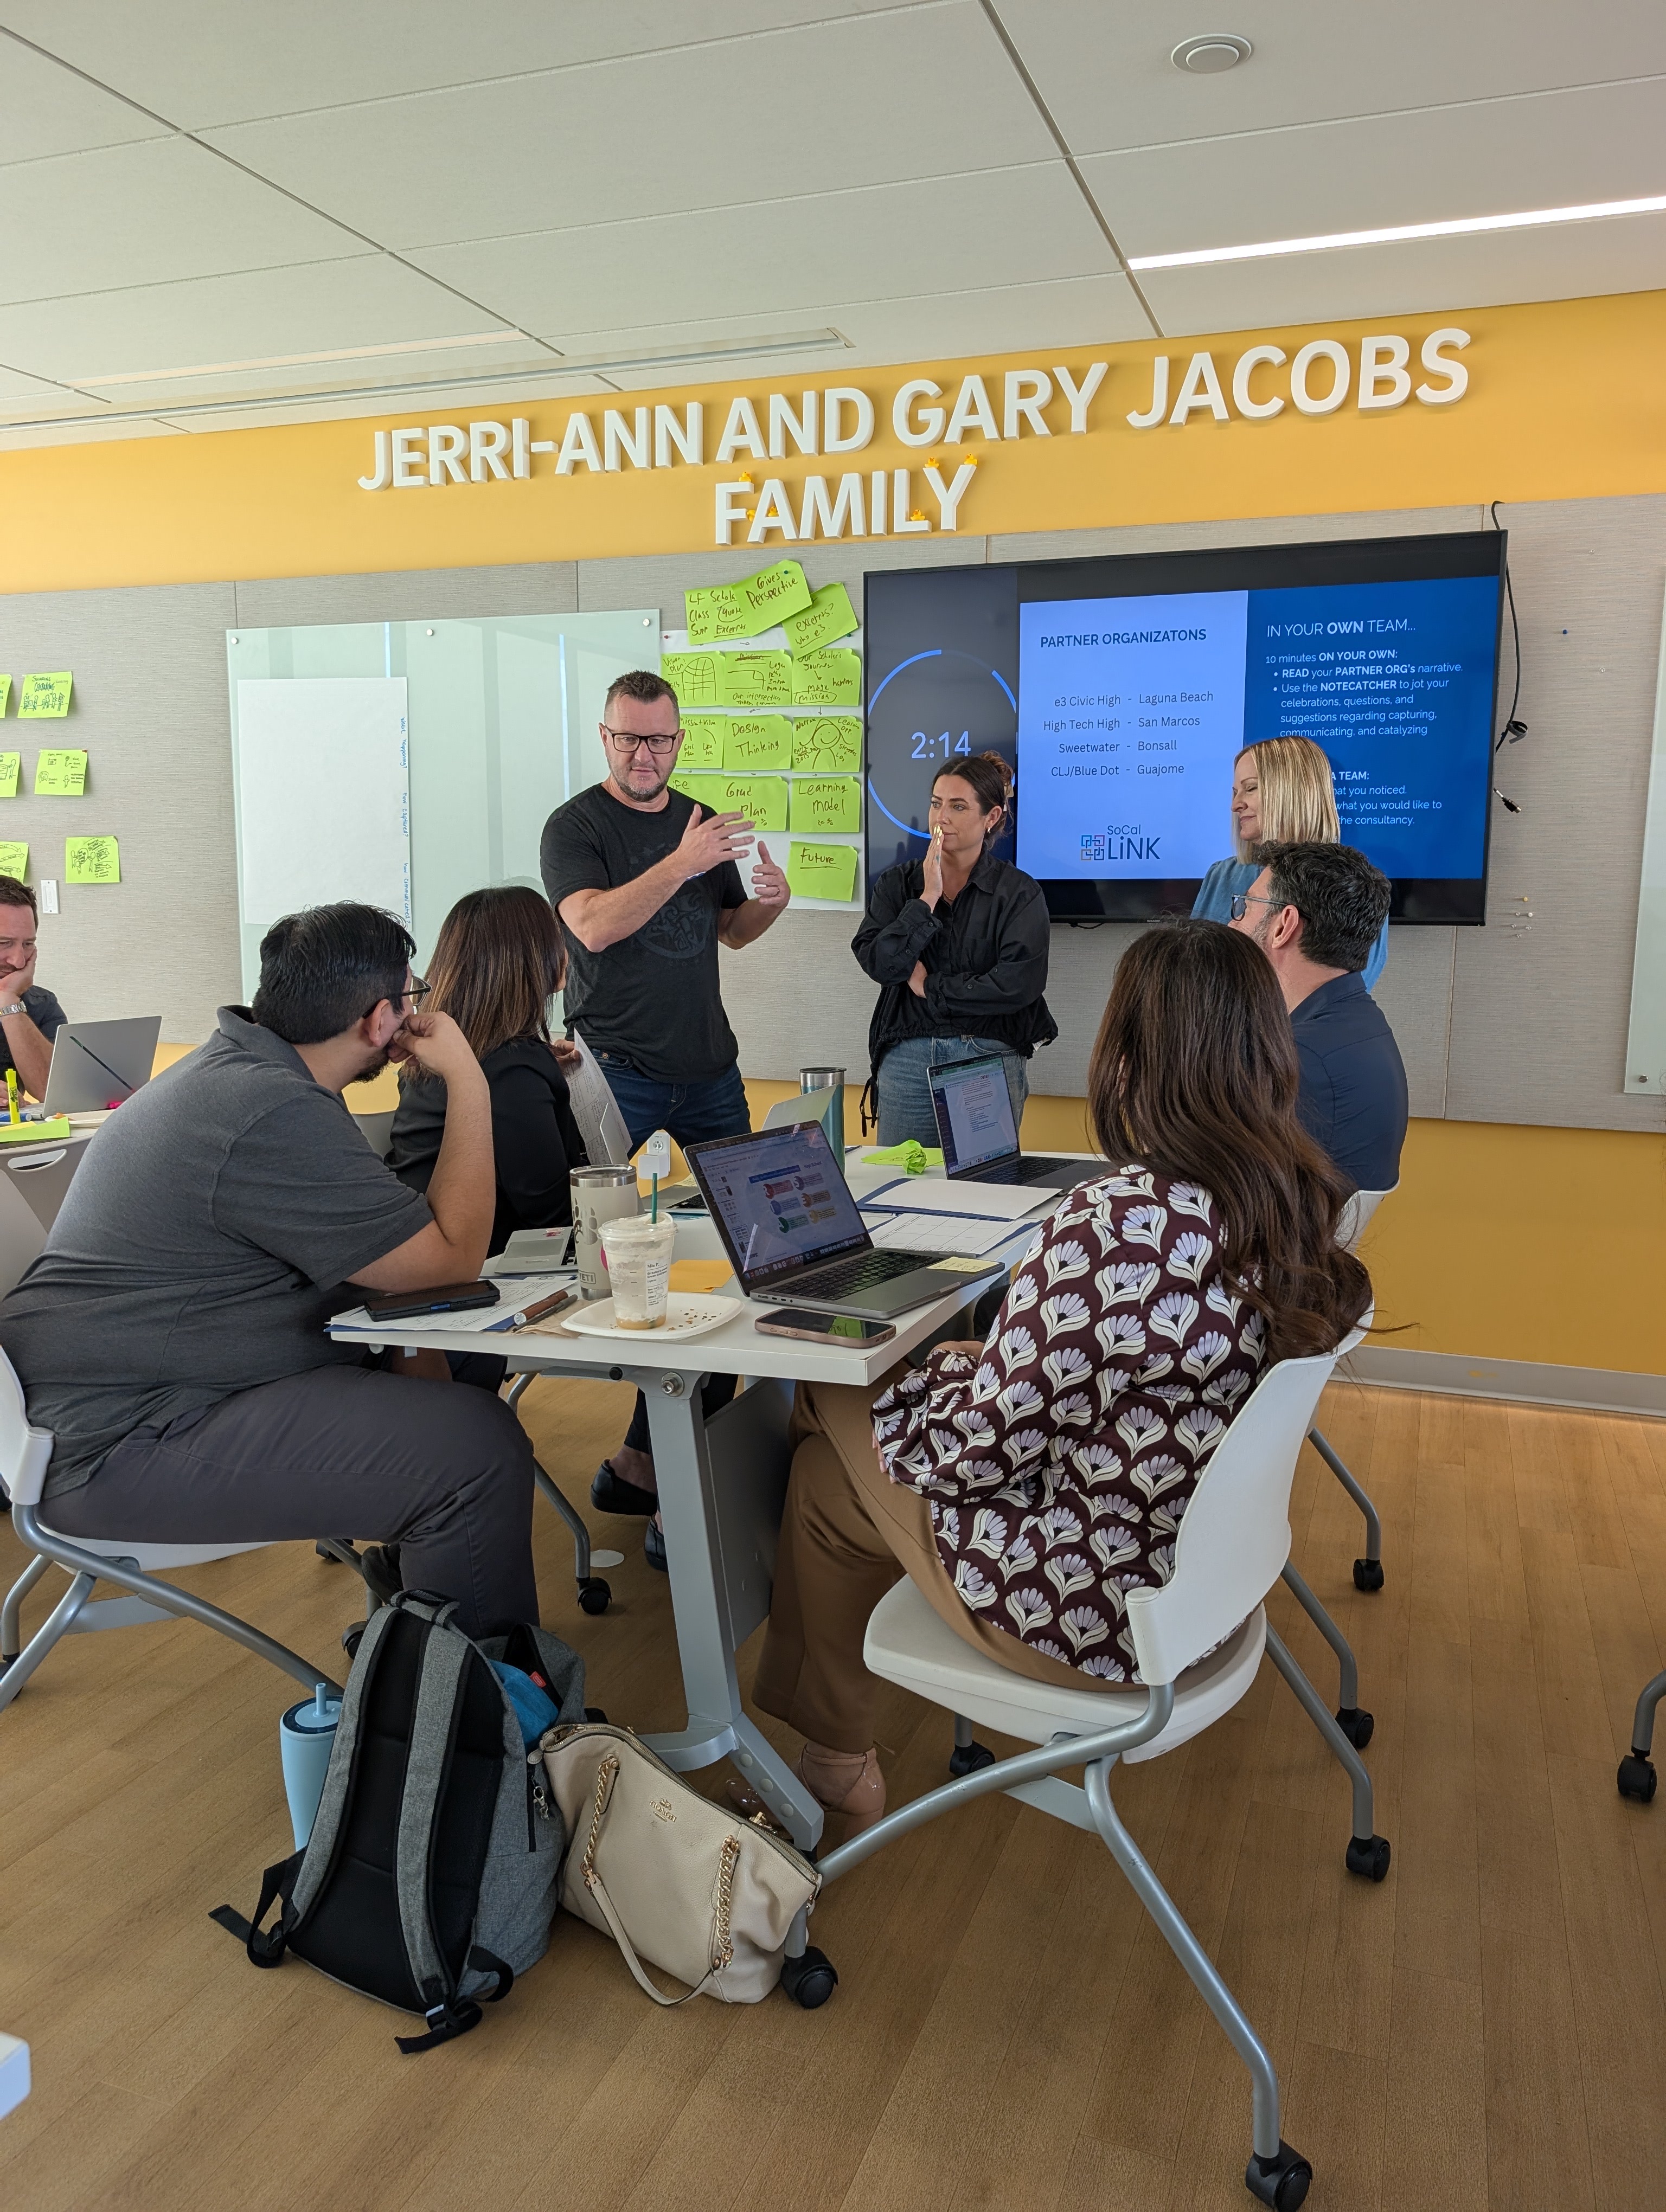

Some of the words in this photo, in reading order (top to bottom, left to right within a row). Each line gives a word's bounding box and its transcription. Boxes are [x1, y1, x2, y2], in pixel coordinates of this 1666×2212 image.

[357, 401, 703, 492] JERRI-ANN
[715, 387, 876, 462] AND
[892, 362, 1109, 449] GARY
[1125, 327, 1472, 430] JACOBS
[715, 464, 977, 546] FAMILY
[745, 577, 799, 610] Perspective
[1267, 625, 1280, 638] IN
[1284, 622, 1323, 636] YOUR
[1327, 620, 1364, 634] OWN
[1367, 618, 1416, 633] TEAM...
[1041, 634, 1099, 648] PARTNER
[1102, 628, 1207, 645] ORGANIZATONS
[1266, 655, 1276, 664] 10
[1279, 653, 1316, 663] minutes
[1319, 652, 1334, 661] ON
[1336, 650, 1366, 661] YOUR
[1368, 649, 1398, 659] OWN:
[1282, 668, 1309, 678] READ
[1311, 669, 1333, 679] your
[1335, 665, 1383, 676] PARTNER
[1385, 664, 1415, 674] ORG's
[1418, 663, 1463, 673] narrative.
[1281, 683, 1300, 693] Use
[1303, 683, 1318, 692] the
[1320, 680, 1397, 692] NOTECATCHER
[1399, 680, 1409, 689] to
[1410, 678, 1424, 690] jot
[1427, 680, 1450, 690] your
[1054, 697, 1066, 707] e3
[1069, 695, 1094, 706] Civic
[1098, 695, 1121, 708] High
[1139, 693, 1177, 706] Laguna
[1181, 691, 1214, 702] Beach
[1281, 697, 1341, 708] celebrations,
[1343, 696, 1392, 708] questions,
[1395, 694, 1414, 704] and
[1043, 719, 1066, 732] High
[1069, 718, 1094, 730] Tech
[1097, 718, 1120, 731] High
[1138, 717, 1157, 728] San
[1161, 716, 1200, 726] Marcos
[1280, 712, 1337, 725] suggestions
[1340, 711, 1386, 723] regarding
[1388, 710, 1437, 721] capturing,
[1280, 728, 1355, 738] communicating,
[1358, 725, 1376, 735] and
[1379, 724, 1428, 736] catalyzing
[911, 731, 971, 758] 2:14
[1059, 742, 1120, 753] Sweetwater
[1138, 740, 1177, 751] Bonsall
[1051, 766, 1097, 777] CLJ/Blue
[1100, 765, 1119, 776] Dot
[1137, 763, 1184, 776] Guajome
[1331, 771, 1336, 780] A
[1339, 771, 1370, 781] TEAM:
[1349, 787, 1367, 797] you
[1369, 785, 1407, 794] noticed.
[1336, 801, 1357, 810] what
[1360, 802, 1377, 812] you
[1380, 800, 1410, 809] would
[1413, 800, 1430, 809] like
[1432, 800, 1442, 809] to
[1338, 815, 1353, 825] the
[1355, 815, 1415, 826] consultancy.
[1107, 824, 1141, 835] SoCal
[1108, 835, 1161, 860] LiNK
[649, 1800, 677, 1823] COACH
